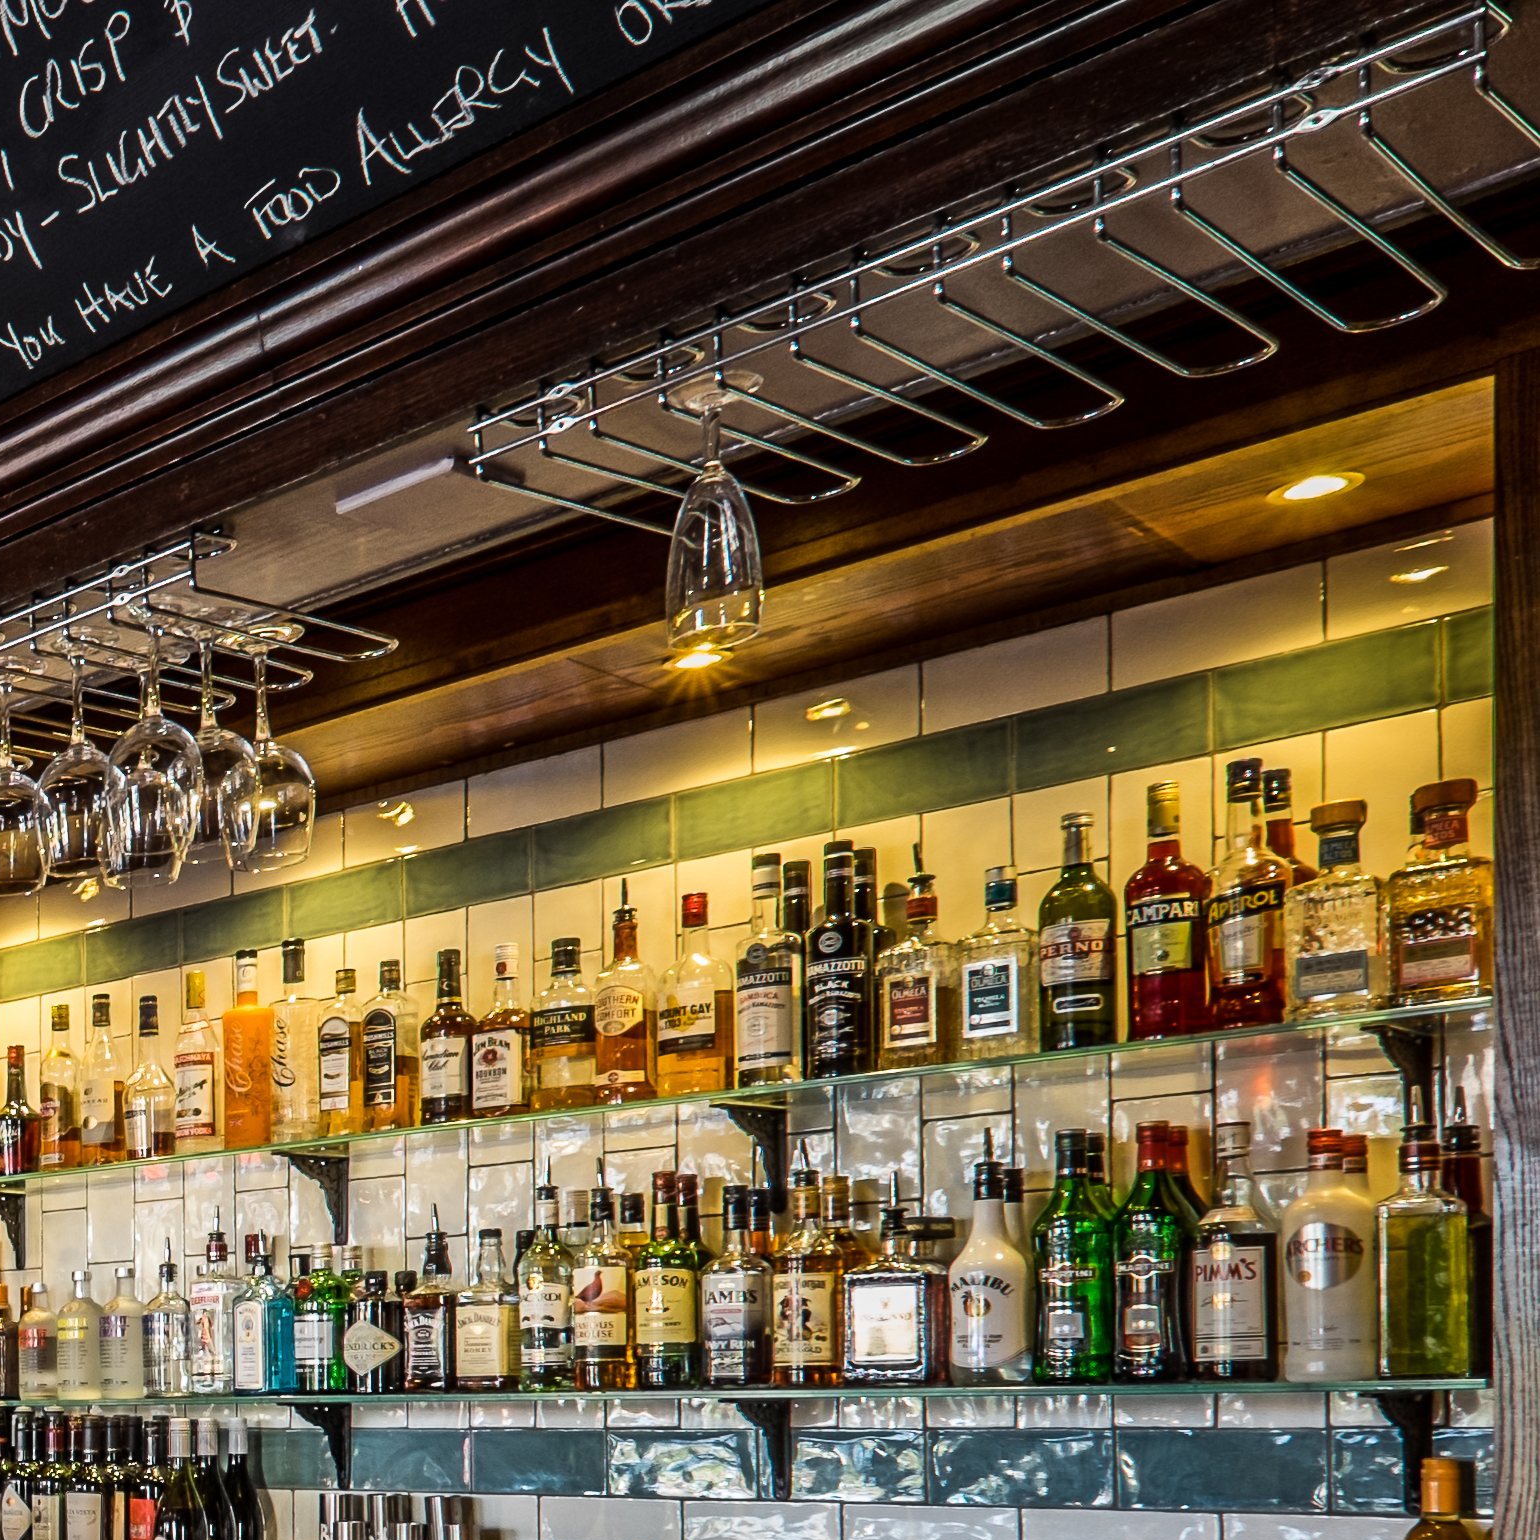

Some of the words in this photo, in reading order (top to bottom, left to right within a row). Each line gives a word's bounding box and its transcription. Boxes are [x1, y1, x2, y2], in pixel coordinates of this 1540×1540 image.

[20, 11, 131, 138] CRISP
[74, 256, 172, 332] HAVE
[192, 225, 236, 266] A
[244, 167, 341, 239] FOOD
[356, 26, 574, 186] ALLERGY
[1208, 888, 1279, 924] APEROL
[892, 986, 928, 999] OLMECA
[689, 1001, 712, 1015] GAY
[534, 1011, 587, 1027] HIGHLAND
[544, 1023, 572, 1035] PARK
[487, 1037, 511, 1051] BEAM
[225, 1020, 253, 1098] Chase
[271, 1017, 297, 1088] Chase
[475, 1066, 507, 1079] BOURBON
[1116, 1260, 1171, 1274] MARTINI
[1195, 1257, 1258, 1283] PIMM'S
[950, 1274, 1016, 1297] MALIBU
[728, 1339, 756, 1350] RUM
